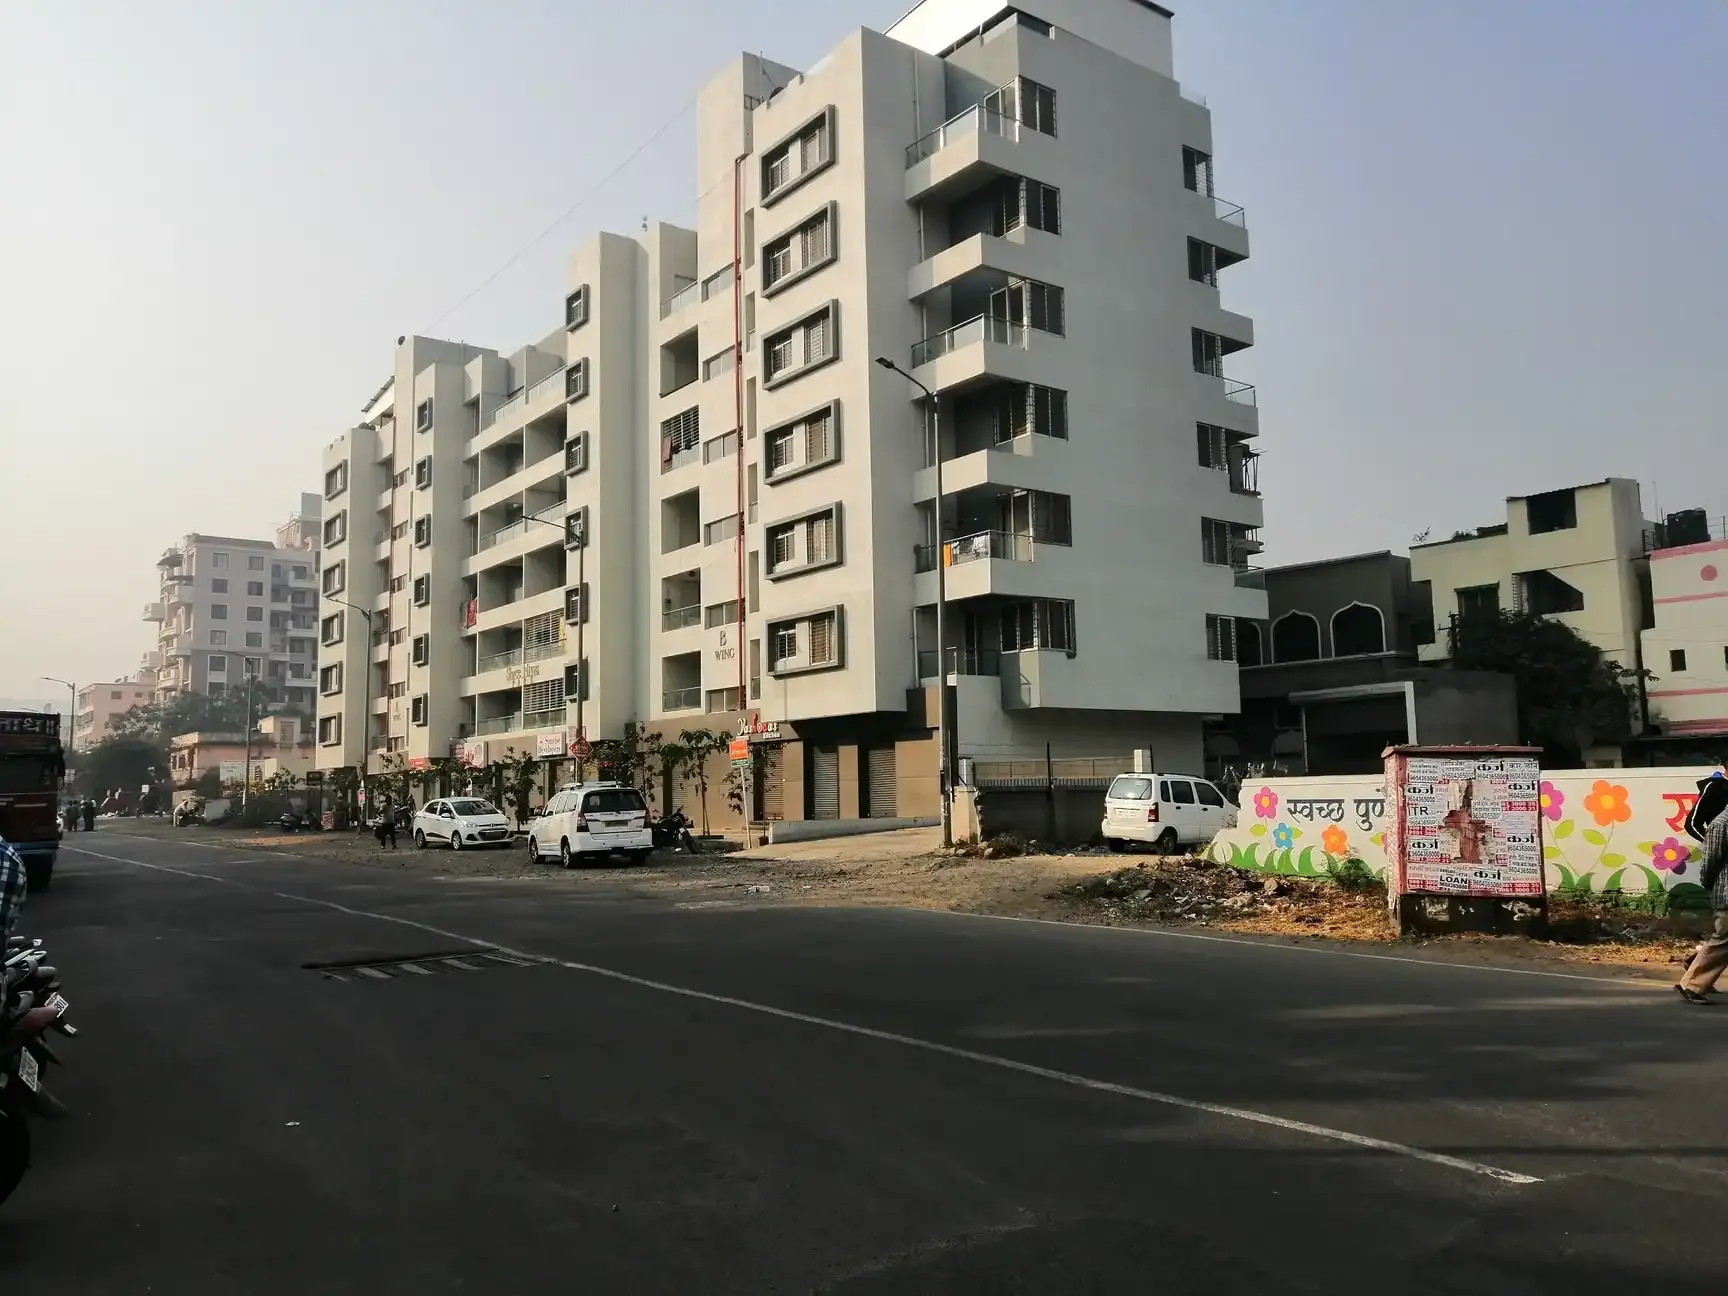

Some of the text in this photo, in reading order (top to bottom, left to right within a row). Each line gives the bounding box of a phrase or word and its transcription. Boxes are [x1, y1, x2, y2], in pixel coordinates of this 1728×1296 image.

[720, 630, 728, 647] B
[714, 647, 736, 661] WING
[1286, 799, 1344, 824] स्वच्छ
[1408, 807, 1429, 816] ITR
[1440, 875, 1468, 885] LOAN
